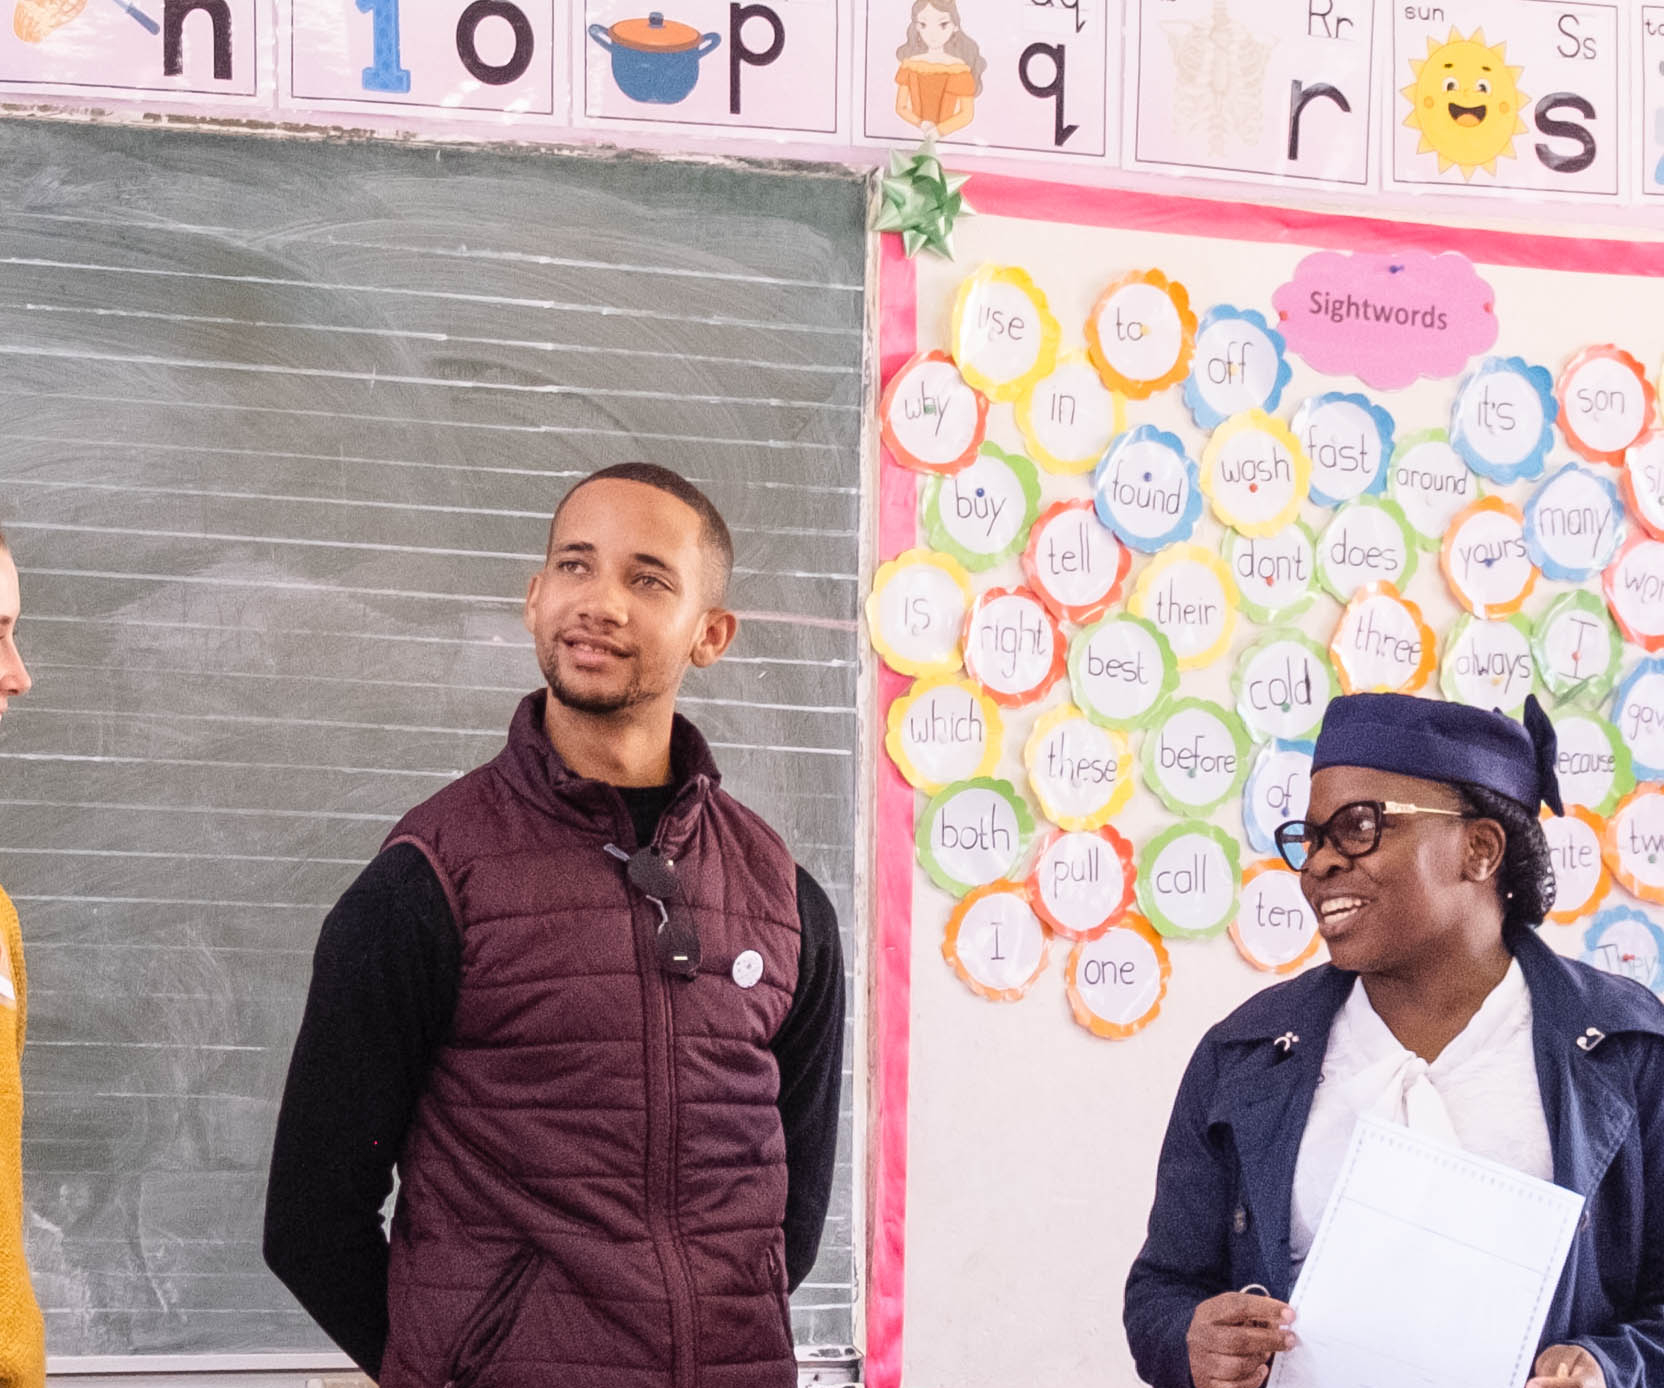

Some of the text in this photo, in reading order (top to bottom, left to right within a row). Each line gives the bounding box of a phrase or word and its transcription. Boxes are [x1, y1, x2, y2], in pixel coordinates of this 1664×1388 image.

[1032, 0, 1087, 33] q
[1307, 0, 1354, 39] Rr
[1404, 5, 1445, 23] sun
[163, 0, 232, 80] n
[456, 0, 534, 86] o
[730, 2, 785, 115] p
[1557, 13, 1597, 61] Ss
[1018, 41, 1079, 146] q
[1287, 80, 1351, 161] r
[1535, 92, 1597, 173] s
[1116, 307, 1144, 342] to
[1309, 291, 1448, 331] Sightwords
[1208, 341, 1253, 384] off
[904, 381, 950, 436] why
[1050, 393, 1077, 425] in
[1477, 385, 1517, 431] it's
[1577, 388, 1626, 414] son
[1221, 447, 1291, 484] wash
[1308, 425, 1371, 474] fast
[1112, 459, 1184, 515] found
[1396, 466, 1468, 495] around
[955, 479, 1007, 537] buy
[1048, 522, 1091, 575] tell
[1330, 527, 1399, 571] does
[1539, 507, 1611, 558] many
[1460, 537, 1528, 580] yours
[903, 597, 931, 631] is
[1157, 577, 1218, 625] their
[981, 610, 1046, 678] right
[1355, 609, 1423, 666] three
[1558, 617, 1598, 680] I
[1088, 645, 1149, 685] best
[1249, 655, 1312, 710] cold
[1456, 637, 1531, 694] always
[910, 698, 983, 743] which
[1048, 731, 1118, 783] these
[1160, 731, 1236, 774] before
[1558, 750, 1616, 775] ecause
[1266, 773, 1299, 808] of
[941, 803, 1010, 850] both
[1054, 847, 1099, 899] pull
[1156, 853, 1206, 894] call
[1550, 834, 1593, 869] rite
[1255, 892, 1303, 930] ten
[990, 922, 1005, 961] I
[1084, 959, 1136, 985] one
